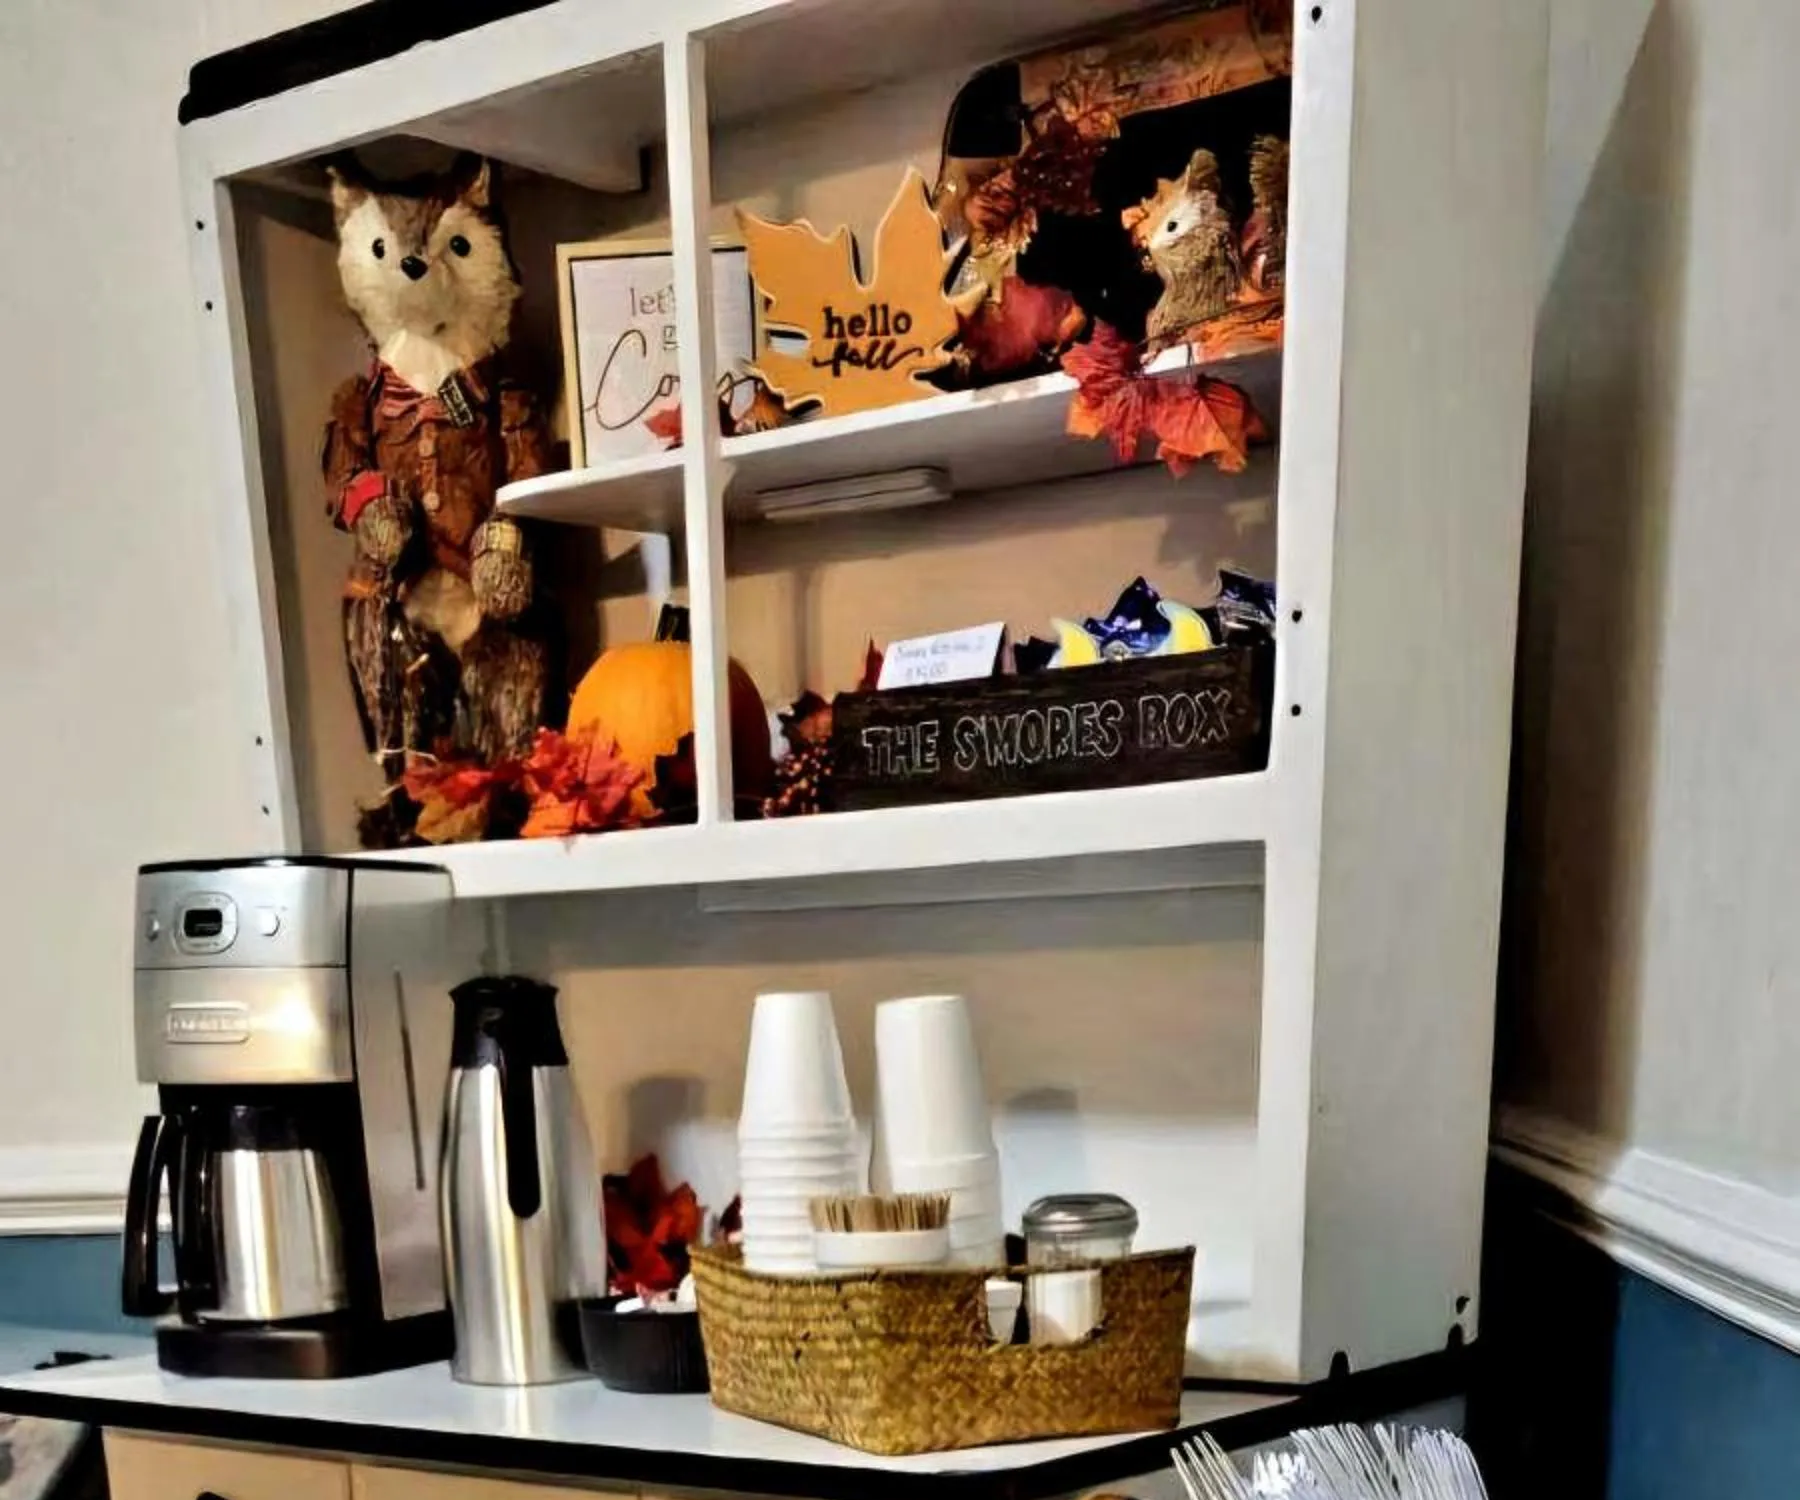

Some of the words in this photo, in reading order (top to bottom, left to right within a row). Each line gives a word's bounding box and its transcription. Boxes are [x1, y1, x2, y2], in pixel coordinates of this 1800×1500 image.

[821, 303, 913, 339] hello
[812, 339, 925, 378] fall
[861, 719, 940, 776] THE
[1138, 687, 1232, 749] BOX
